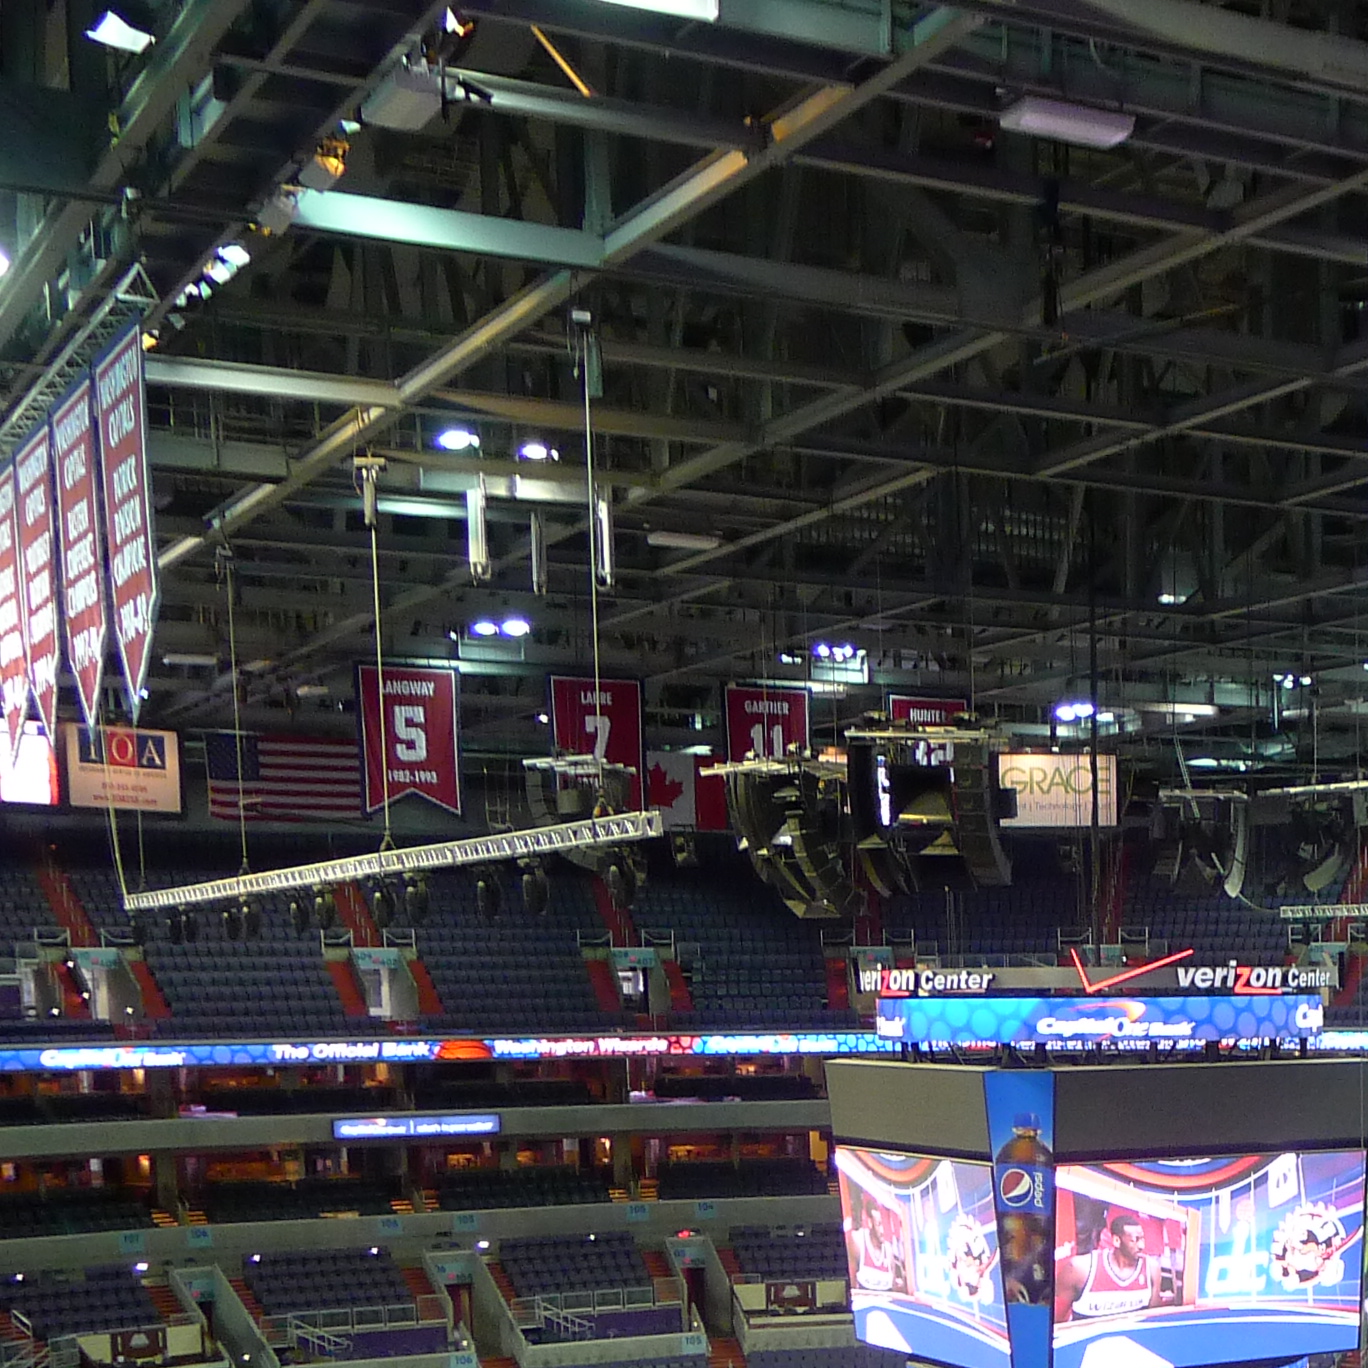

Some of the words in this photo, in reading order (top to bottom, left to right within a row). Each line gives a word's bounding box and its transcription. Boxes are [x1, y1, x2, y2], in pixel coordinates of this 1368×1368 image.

[393, 705, 428, 762] 5
[920, 970, 993, 990] Center
[1177, 960, 1283, 994] verizon
[1288, 967, 1331, 988] Center
[273, 1043, 309, 1060] The
[313, 1042, 379, 1058] Official
[383, 1041, 430, 1057] Bank
[1033, 1172, 1044, 1208] pepsi
